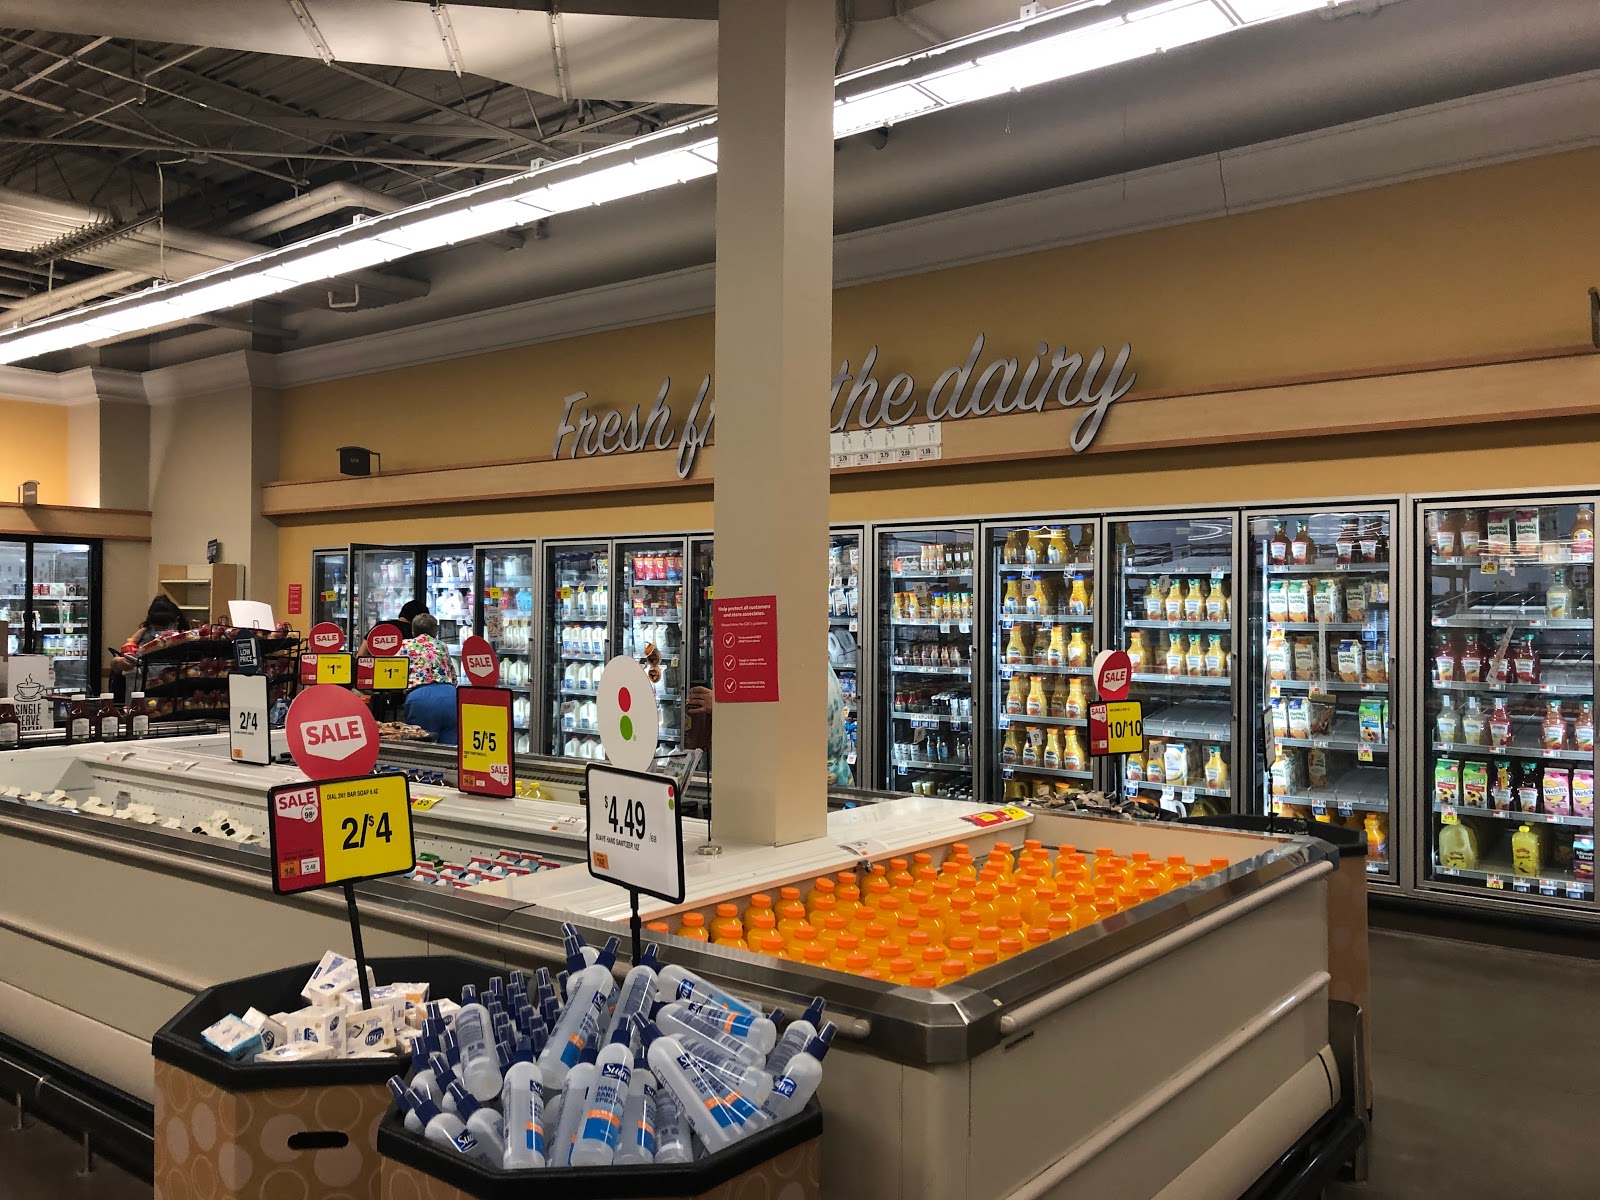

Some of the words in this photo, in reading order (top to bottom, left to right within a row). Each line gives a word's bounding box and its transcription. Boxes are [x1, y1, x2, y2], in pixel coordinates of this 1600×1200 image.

[551, 376, 674, 460] Fresh
[926, 332, 1136, 452] dairy
[316, 634, 338, 642] SALE
[374, 636, 396, 644] SALE
[240, 648, 251, 656] LOW
[469, 657, 492, 668] SALE
[1104, 670, 1125, 683] SALE
[15, 703, 42, 715] SINGLE
[1091, 706, 1106, 716] SALE
[305, 720, 362, 746] SALE
[490, 765, 508, 775] SALE
[347, 790, 357, 798] BAR
[357, 789, 370, 797] SOAP
[279, 791, 315, 810] SALE
[604, 795, 646, 840] $4.49
[341, 812, 393, 850] 2/$4
